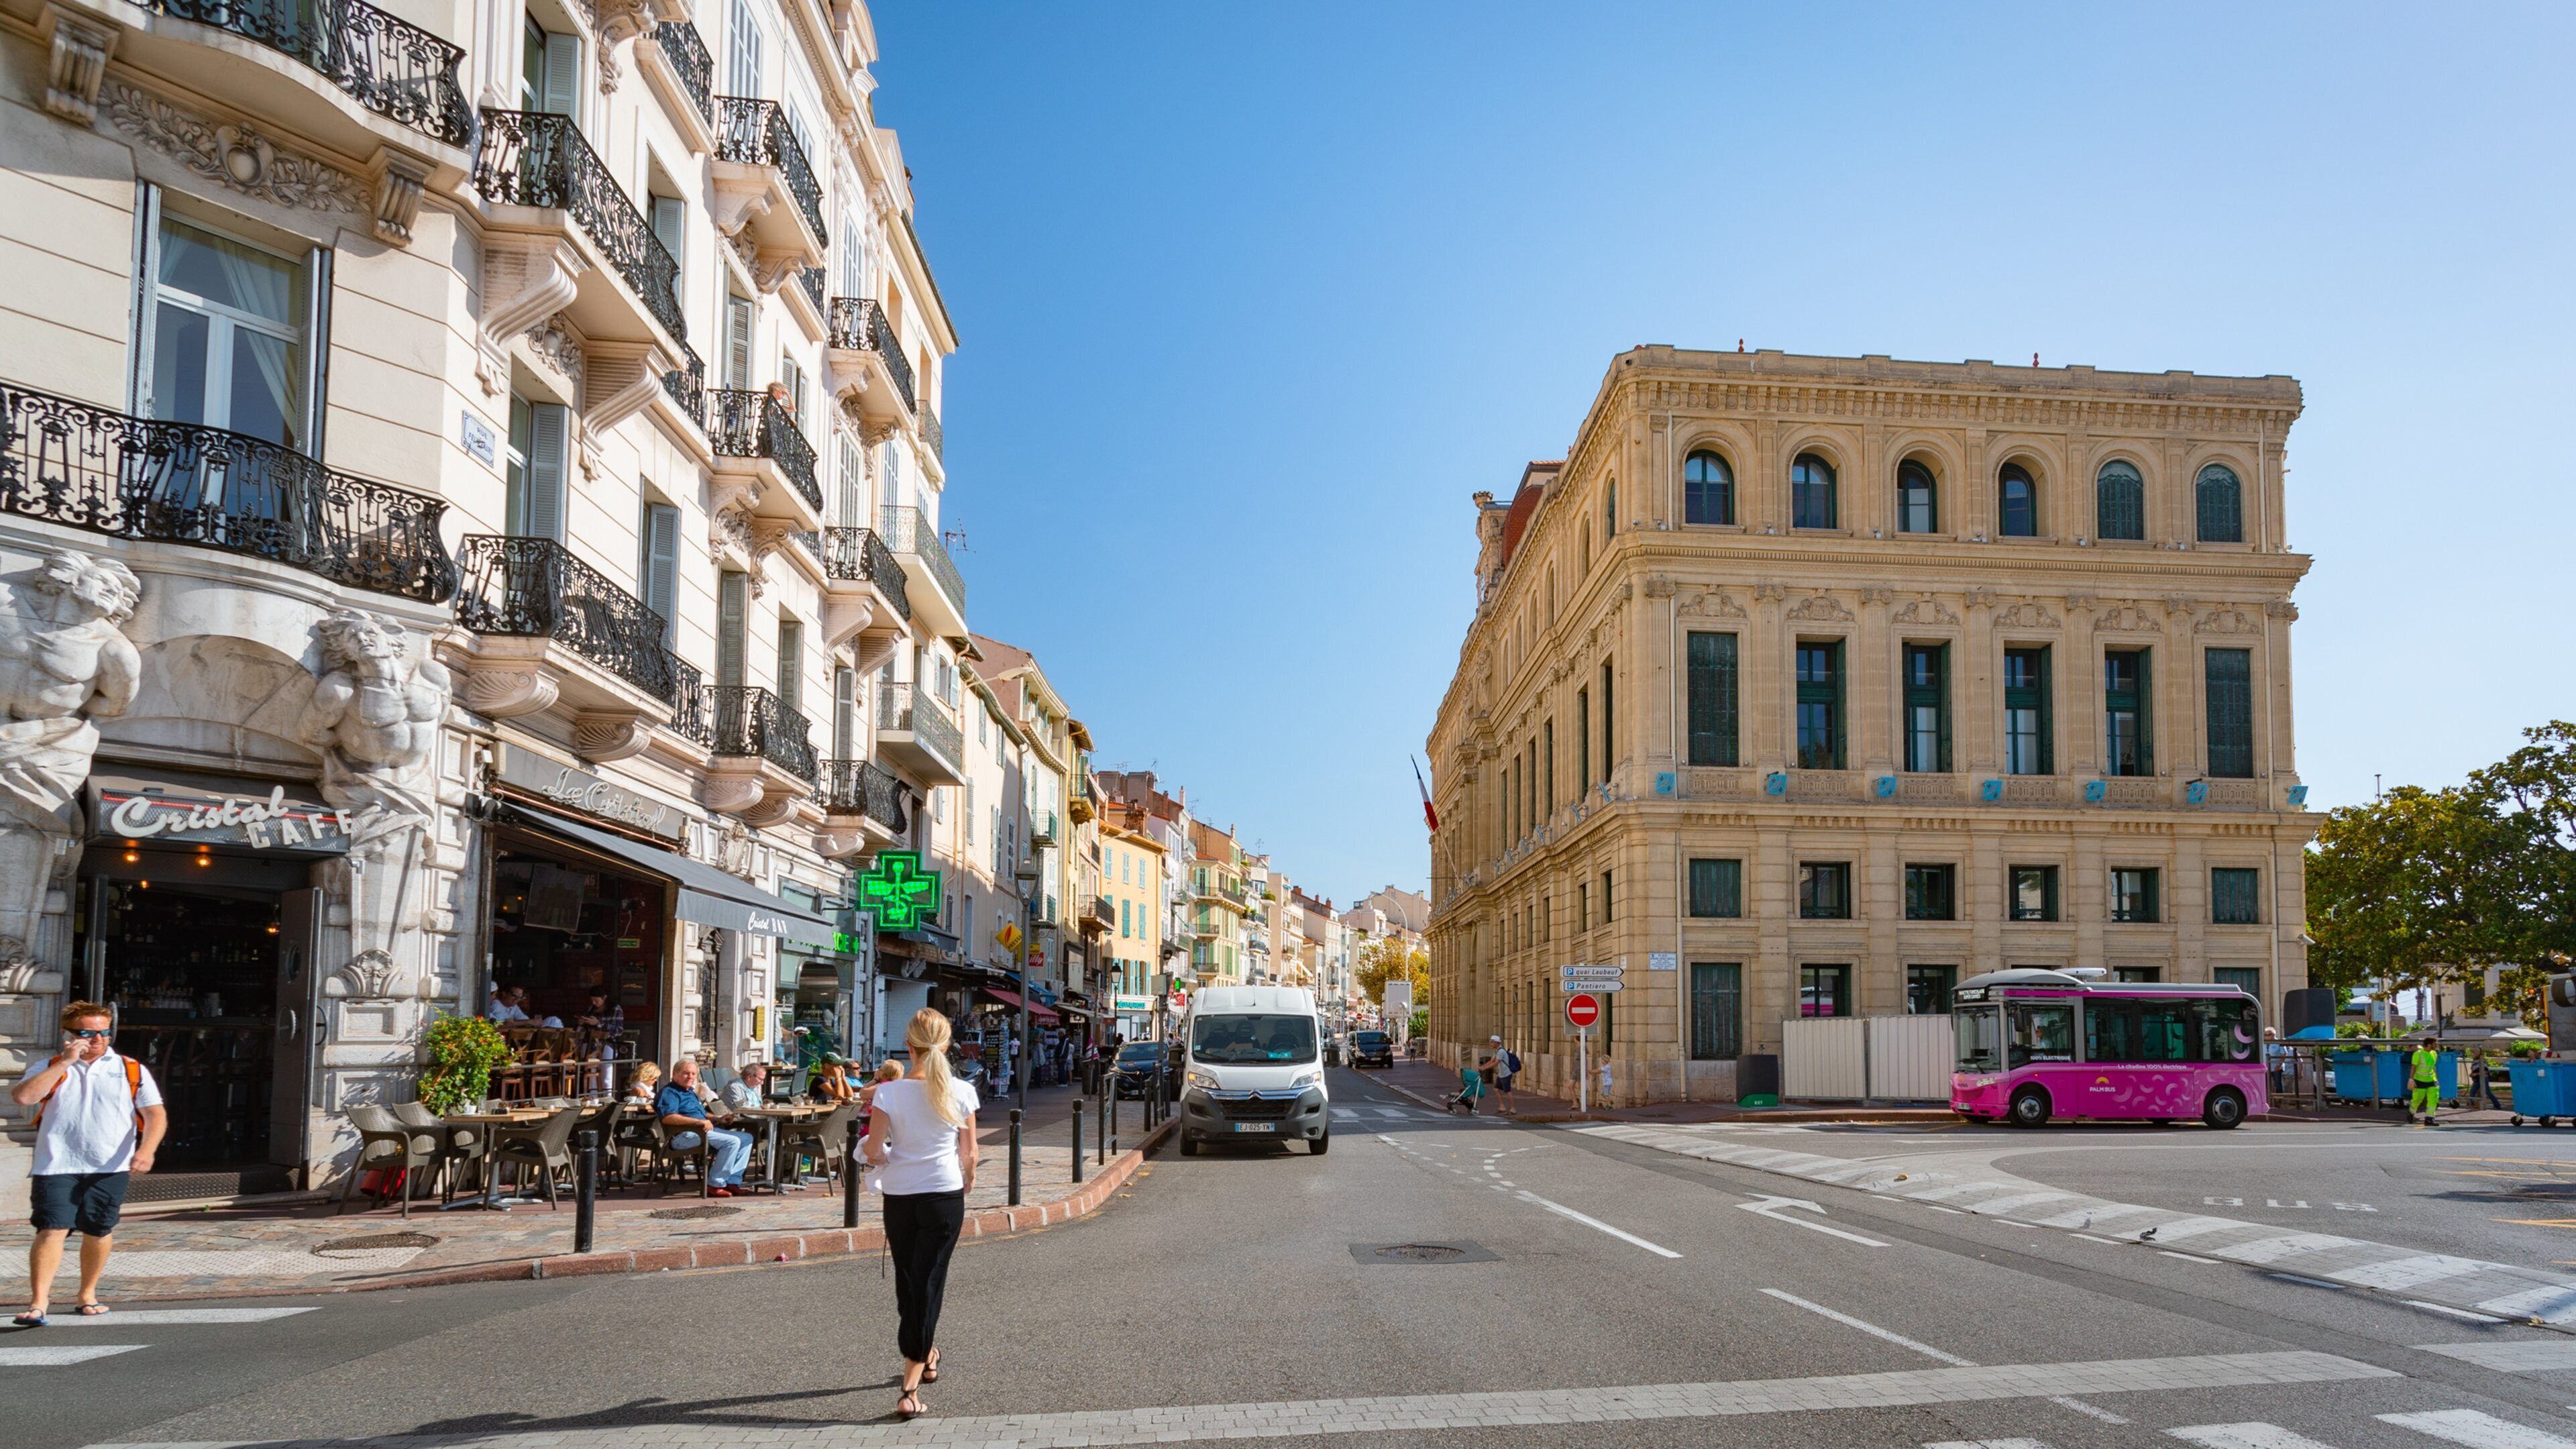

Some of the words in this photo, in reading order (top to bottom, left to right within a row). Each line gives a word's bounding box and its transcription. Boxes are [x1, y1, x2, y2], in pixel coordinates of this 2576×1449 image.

[477, 427, 486, 439] RUE
[542, 767, 583, 804] Le
[111, 786, 289, 838] Cristal
[247, 808, 354, 849] CAFE
[748, 911, 770, 931] Cristal
[771, 917, 788, 934] BAR
[1030, 955, 1043, 965] illy
